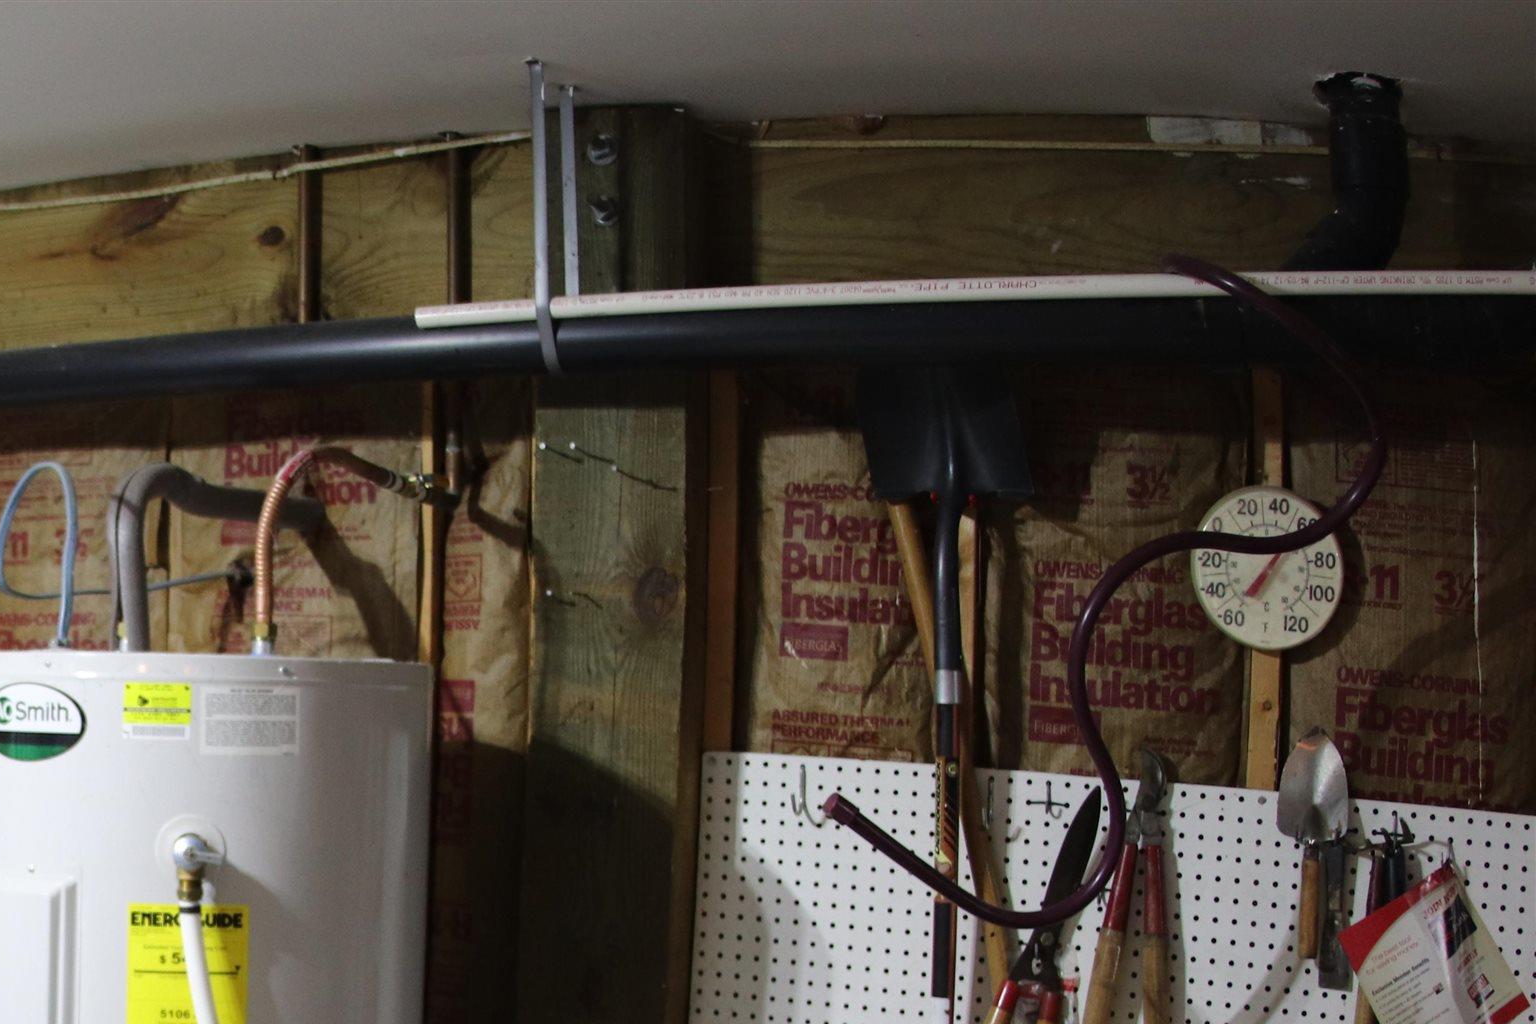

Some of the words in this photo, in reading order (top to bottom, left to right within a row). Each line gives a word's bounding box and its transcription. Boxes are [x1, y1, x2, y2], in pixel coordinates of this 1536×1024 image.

[914, 282, 949, 292] PIPE
[958, 280, 1036, 290] CHARLOTTE
[1380, 276, 1415, 284] DRINKING
[1237, 499, 1258, 516] 20
[1269, 498, 1290, 515] 40
[1308, 585, 1335, 602] 100
[1218, 610, 1245, 626] -60
[1284, 616, 1309, 633] 120
[1030, 662, 1221, 714] Inulation
[16, 701, 70, 722] Smith
[772, 709, 838, 726] ASSURED
[1335, 686, 1510, 748] Fiberglas
[1335, 731, 1495, 797] Building
